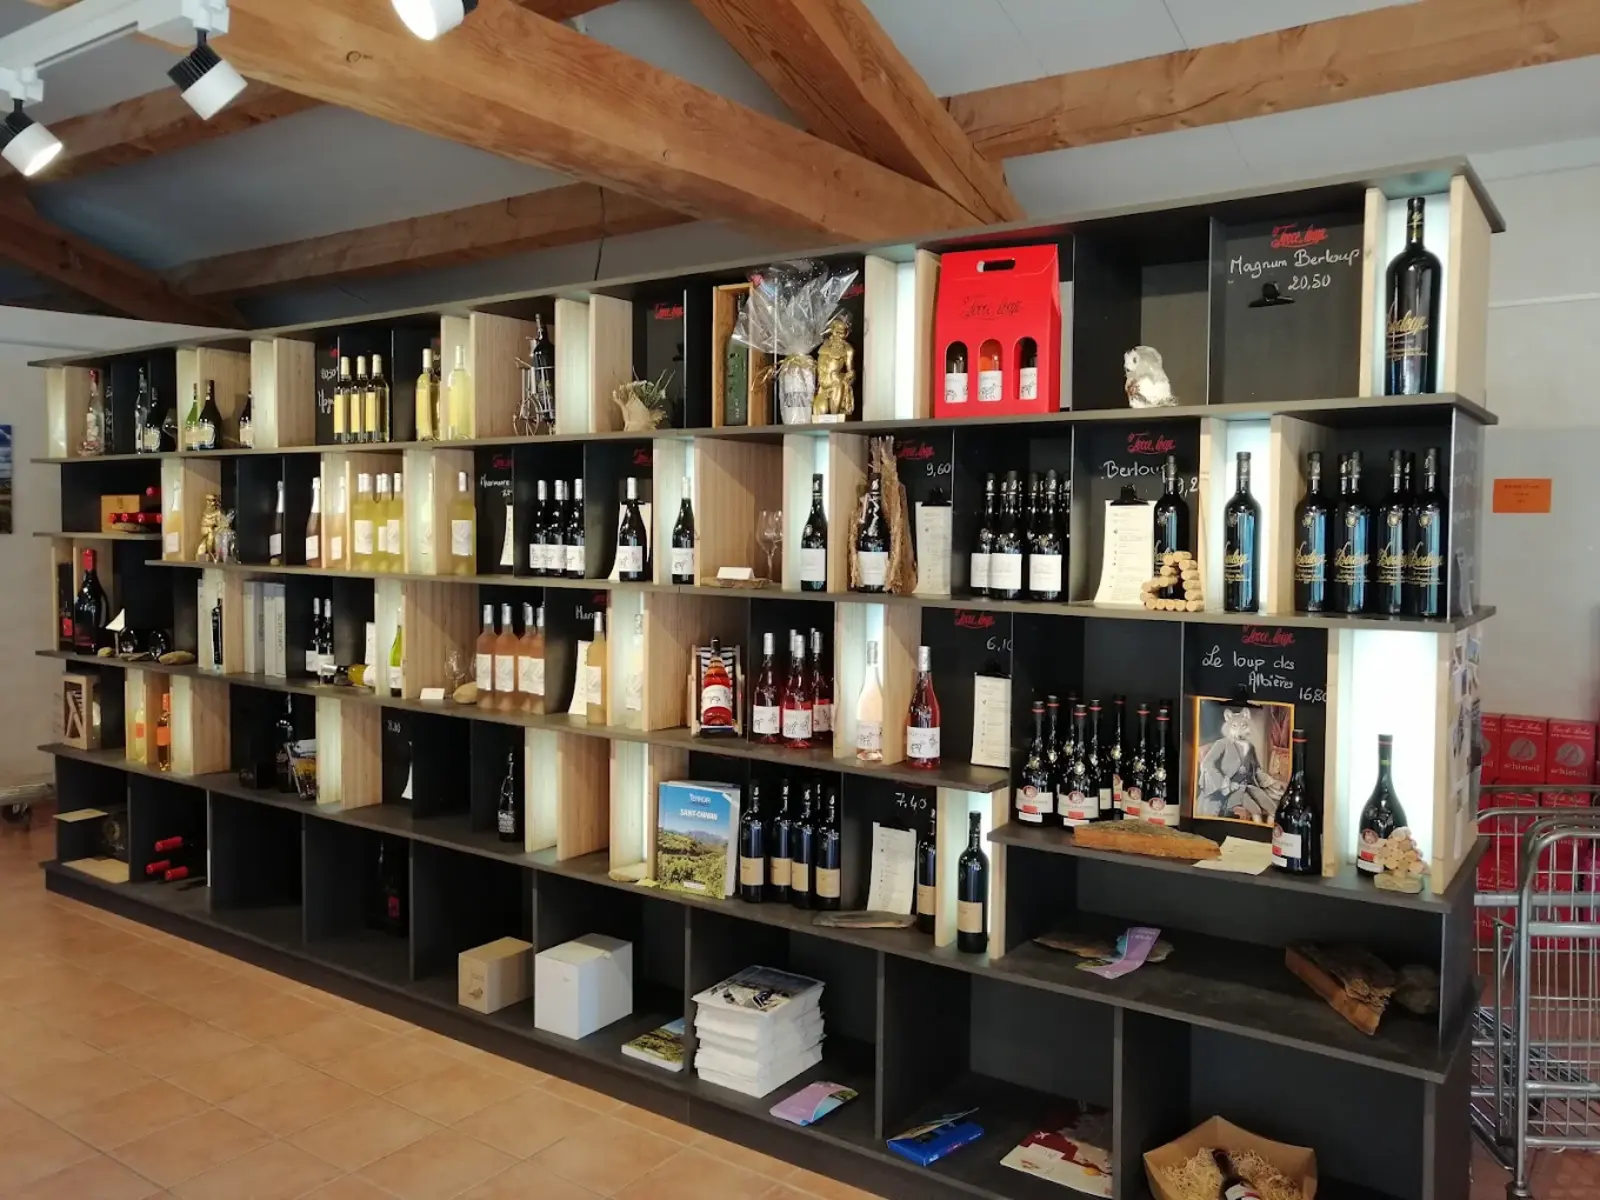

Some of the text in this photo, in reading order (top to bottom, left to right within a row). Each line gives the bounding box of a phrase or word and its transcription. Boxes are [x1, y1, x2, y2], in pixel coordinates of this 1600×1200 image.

[1230, 255, 1288, 279] Magnum
[1202, 644, 1295, 672] Le loup des
